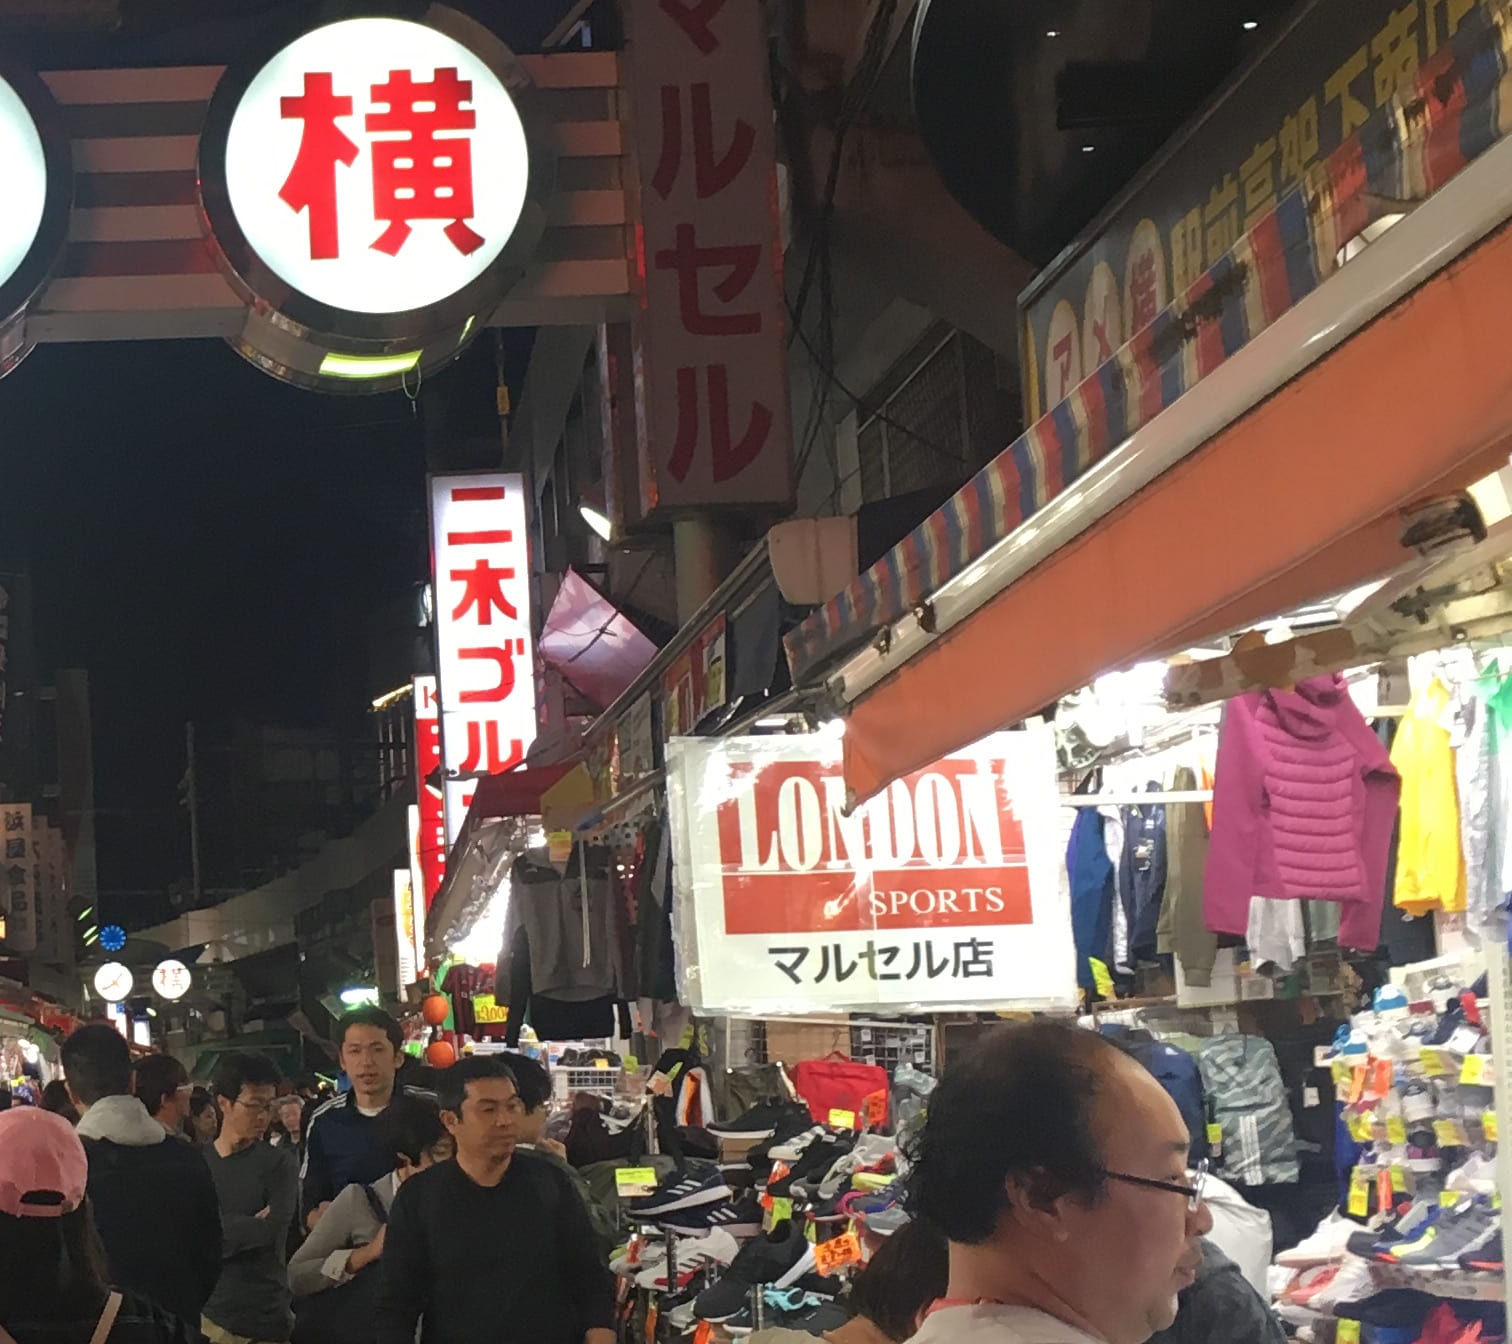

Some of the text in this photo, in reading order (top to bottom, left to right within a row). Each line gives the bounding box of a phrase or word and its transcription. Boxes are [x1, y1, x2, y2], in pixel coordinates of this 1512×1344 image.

[447, 486, 524, 807] 二木ゴル
[734, 772, 1004, 873] LONDON
[869, 886, 1005, 916] SPORTS
[769, 937, 994, 984] マルセル店
